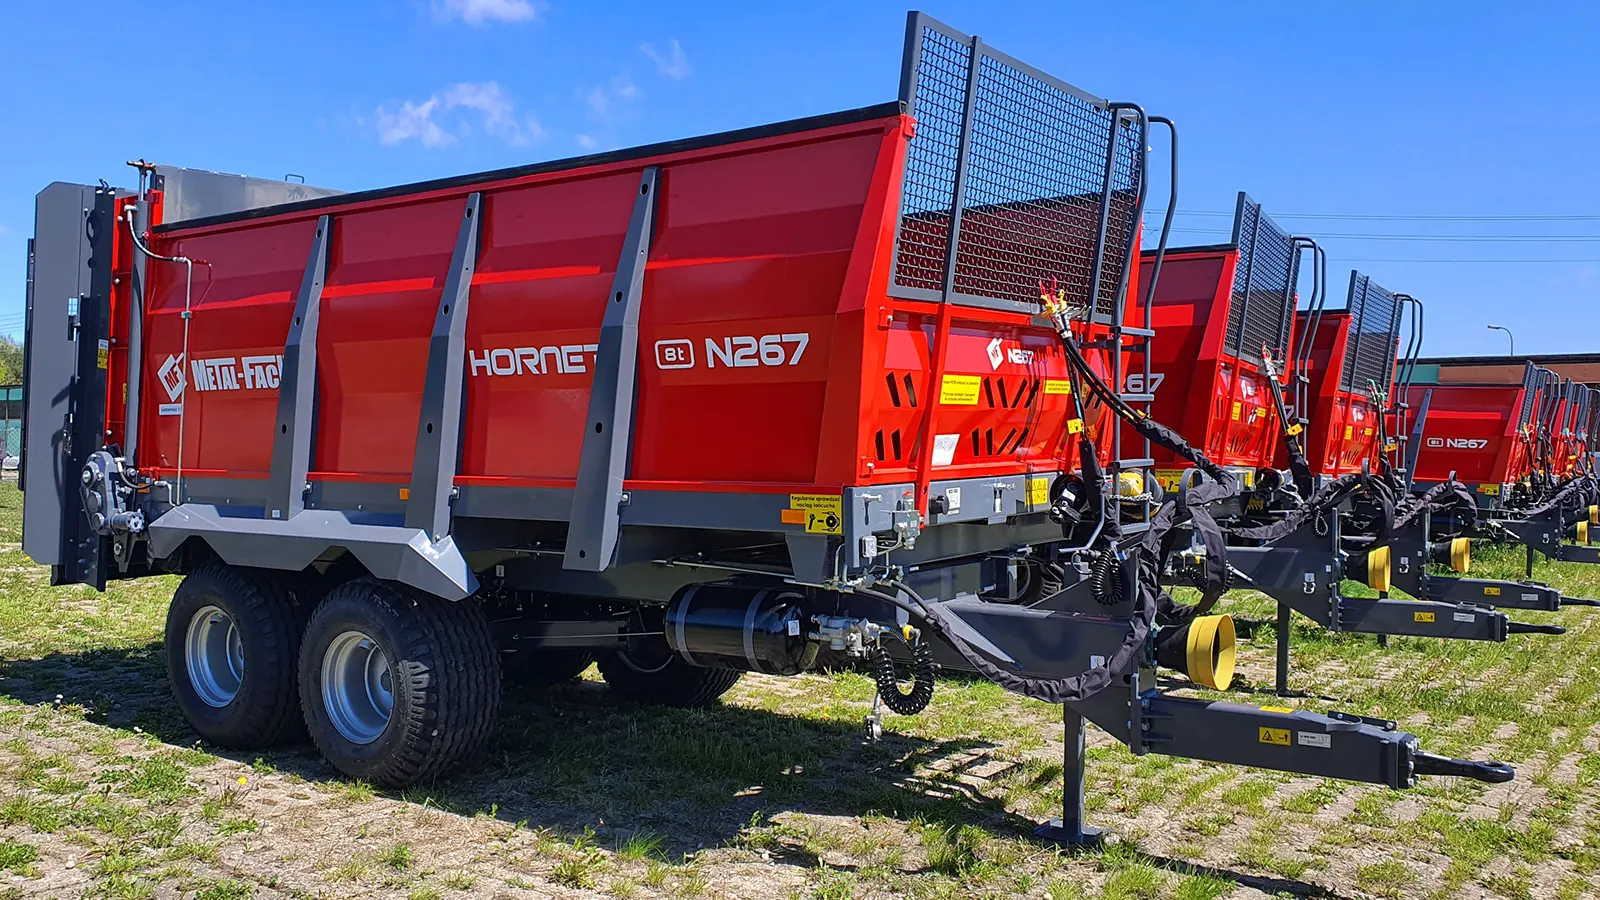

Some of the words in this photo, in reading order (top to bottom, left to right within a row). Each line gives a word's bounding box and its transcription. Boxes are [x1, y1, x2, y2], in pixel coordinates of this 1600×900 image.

[469, 344, 599, 376] HORNET
[664, 347, 685, 362] 8t
[705, 333, 809, 368] N267
[1007, 348, 1034, 365] N267
[1446, 438, 1488, 449] N267
